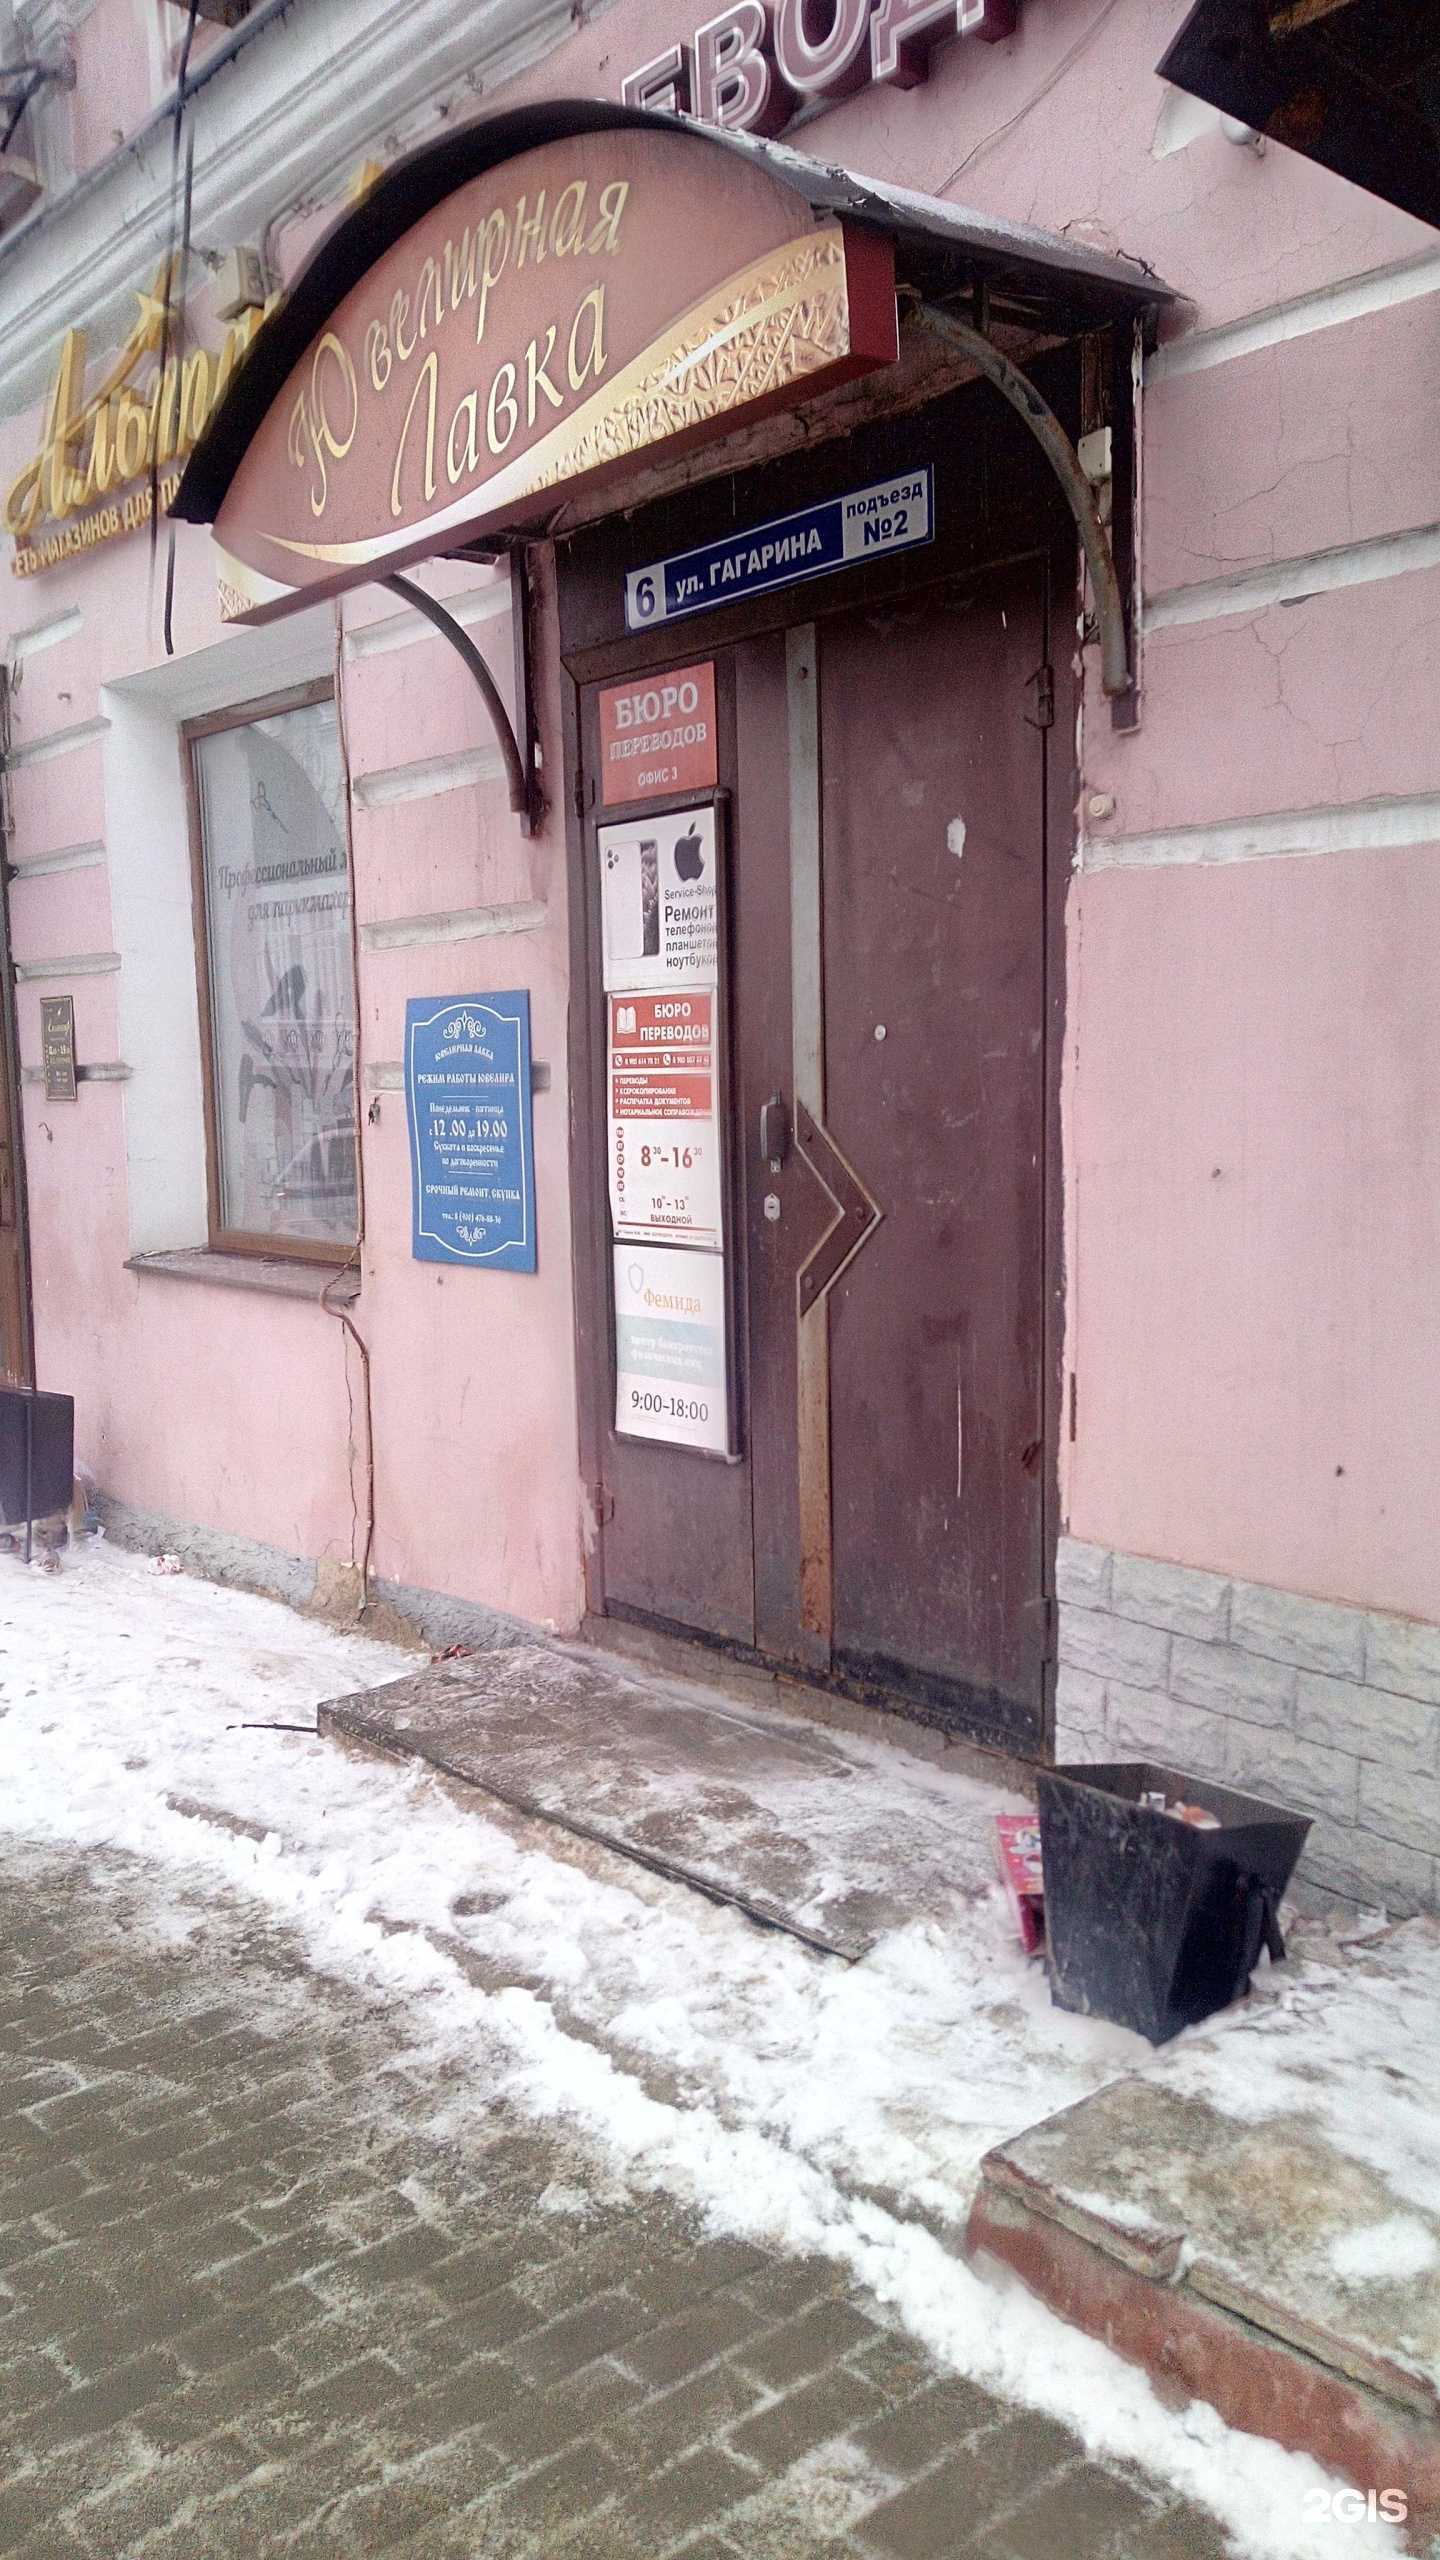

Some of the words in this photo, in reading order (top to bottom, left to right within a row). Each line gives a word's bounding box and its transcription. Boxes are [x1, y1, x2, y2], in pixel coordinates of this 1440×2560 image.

[288, 180, 629, 516] Ювелирная
[391, 280, 608, 516] Лавка
[847, 481, 923, 519] подъезд
[39, 504, 120, 566] МАГАЗИНОВ
[864, 510, 909, 546] №2
[635, 576, 656, 618] 6
[675, 576, 704, 602] ул.
[709, 528, 822, 586] ГАГАРИНА
[614, 682, 698, 729] БЮРО
[609, 723, 707, 761] ПЕРЕВОДОВ
[638, 768, 669, 786] ОФИС
[665, 905, 714, 923] Ремонт
[654, 1002, 691, 1018] БЮРО
[640, 1024, 709, 1041] ПЕРЕВОДОВ
[446, 1073, 477, 1084] РАБОТЫ
[478, 1072, 514, 1083] ЮВЕЛИРА
[476, 1120, 508, 1137] 19.00
[491, 1188, 520, 1201] СКУПКА
[643, 1287, 703, 1315] Фемида
[631, 1390, 709, 1422] 9:00-18:00
